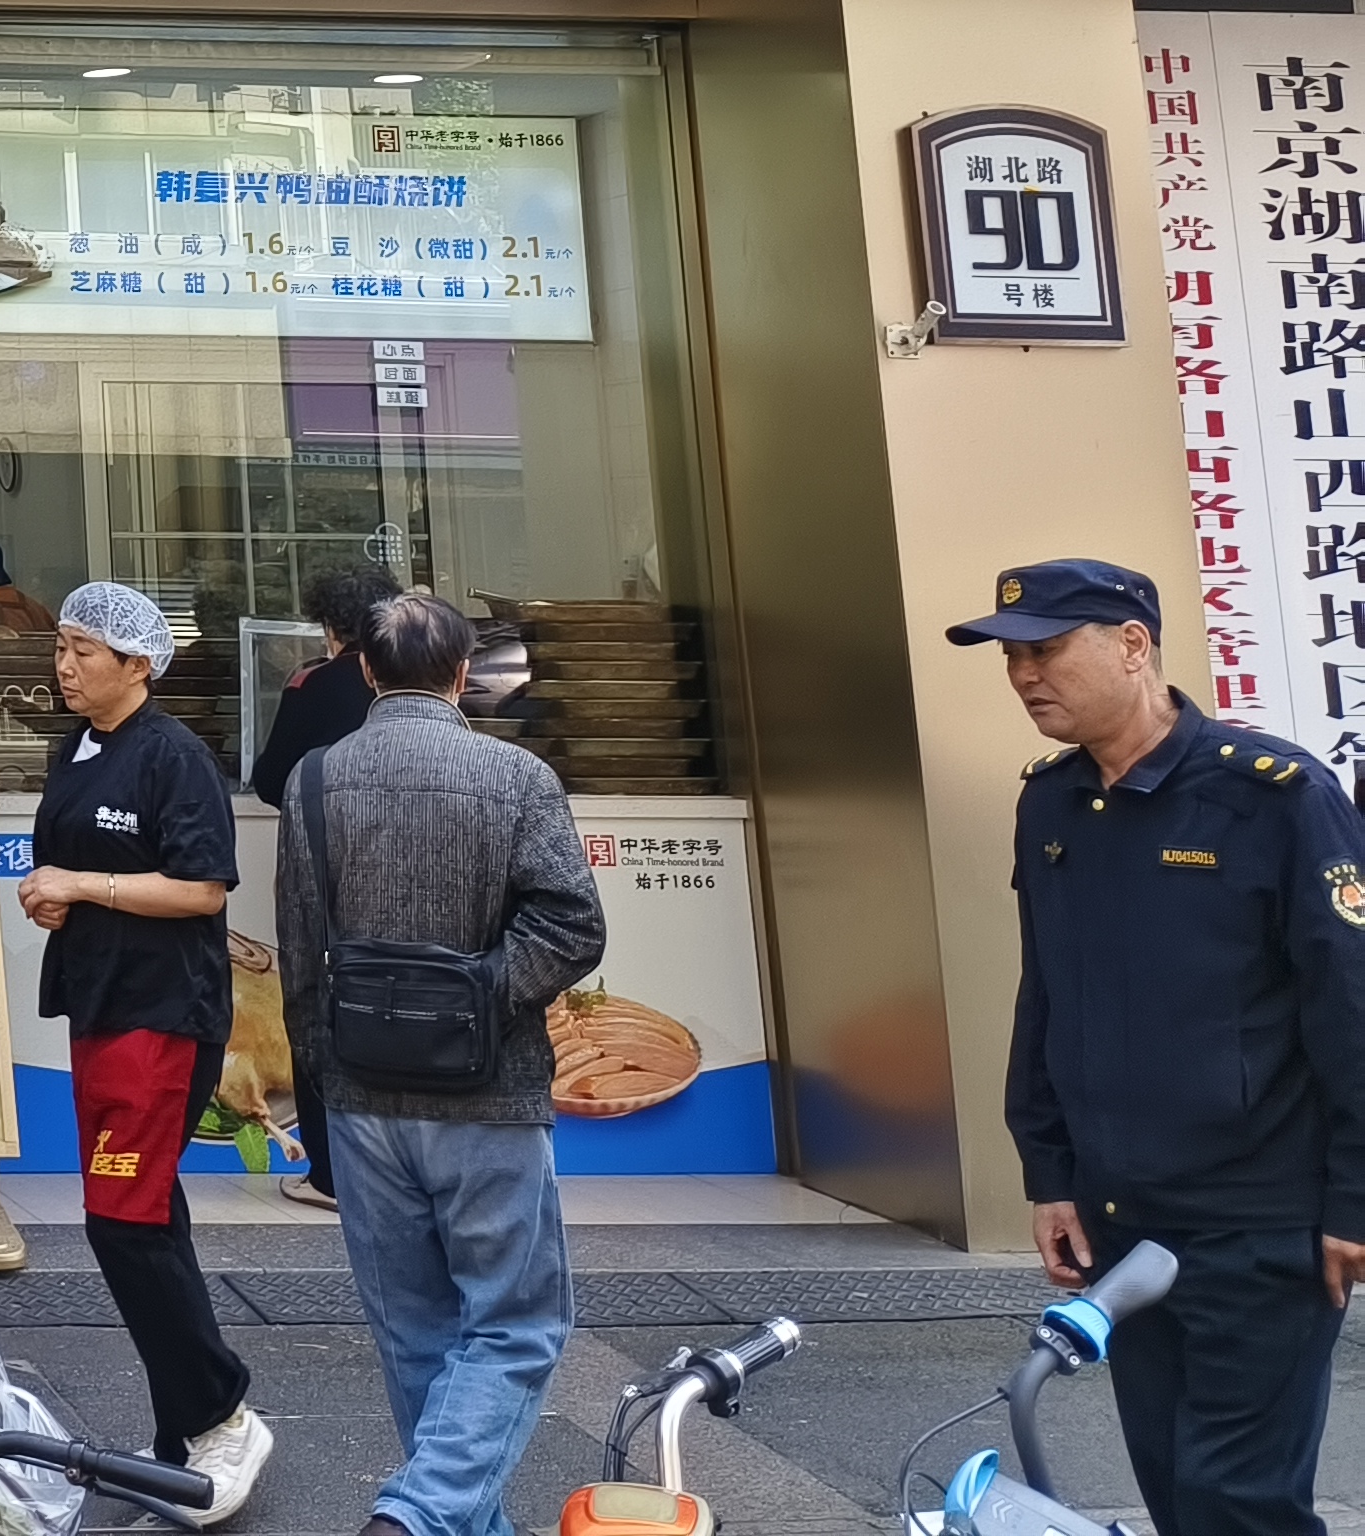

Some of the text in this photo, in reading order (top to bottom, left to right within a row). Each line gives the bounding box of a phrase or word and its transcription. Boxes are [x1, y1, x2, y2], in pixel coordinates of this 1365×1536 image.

[405, 129, 564, 148] 中华老字号 始于1866
[966, 155, 1064, 184] 湖北路
[155, 170, 467, 207] 韩复兴鸭油酥烧饼
[964, 189, 1080, 271] 90
[1002, 283, 1055, 308] 号楼
[619, 838, 722, 856] 中华老字号
[621, 857, 724, 867] China Time-honored Brand
[635, 872, 715, 890] 始于1866
